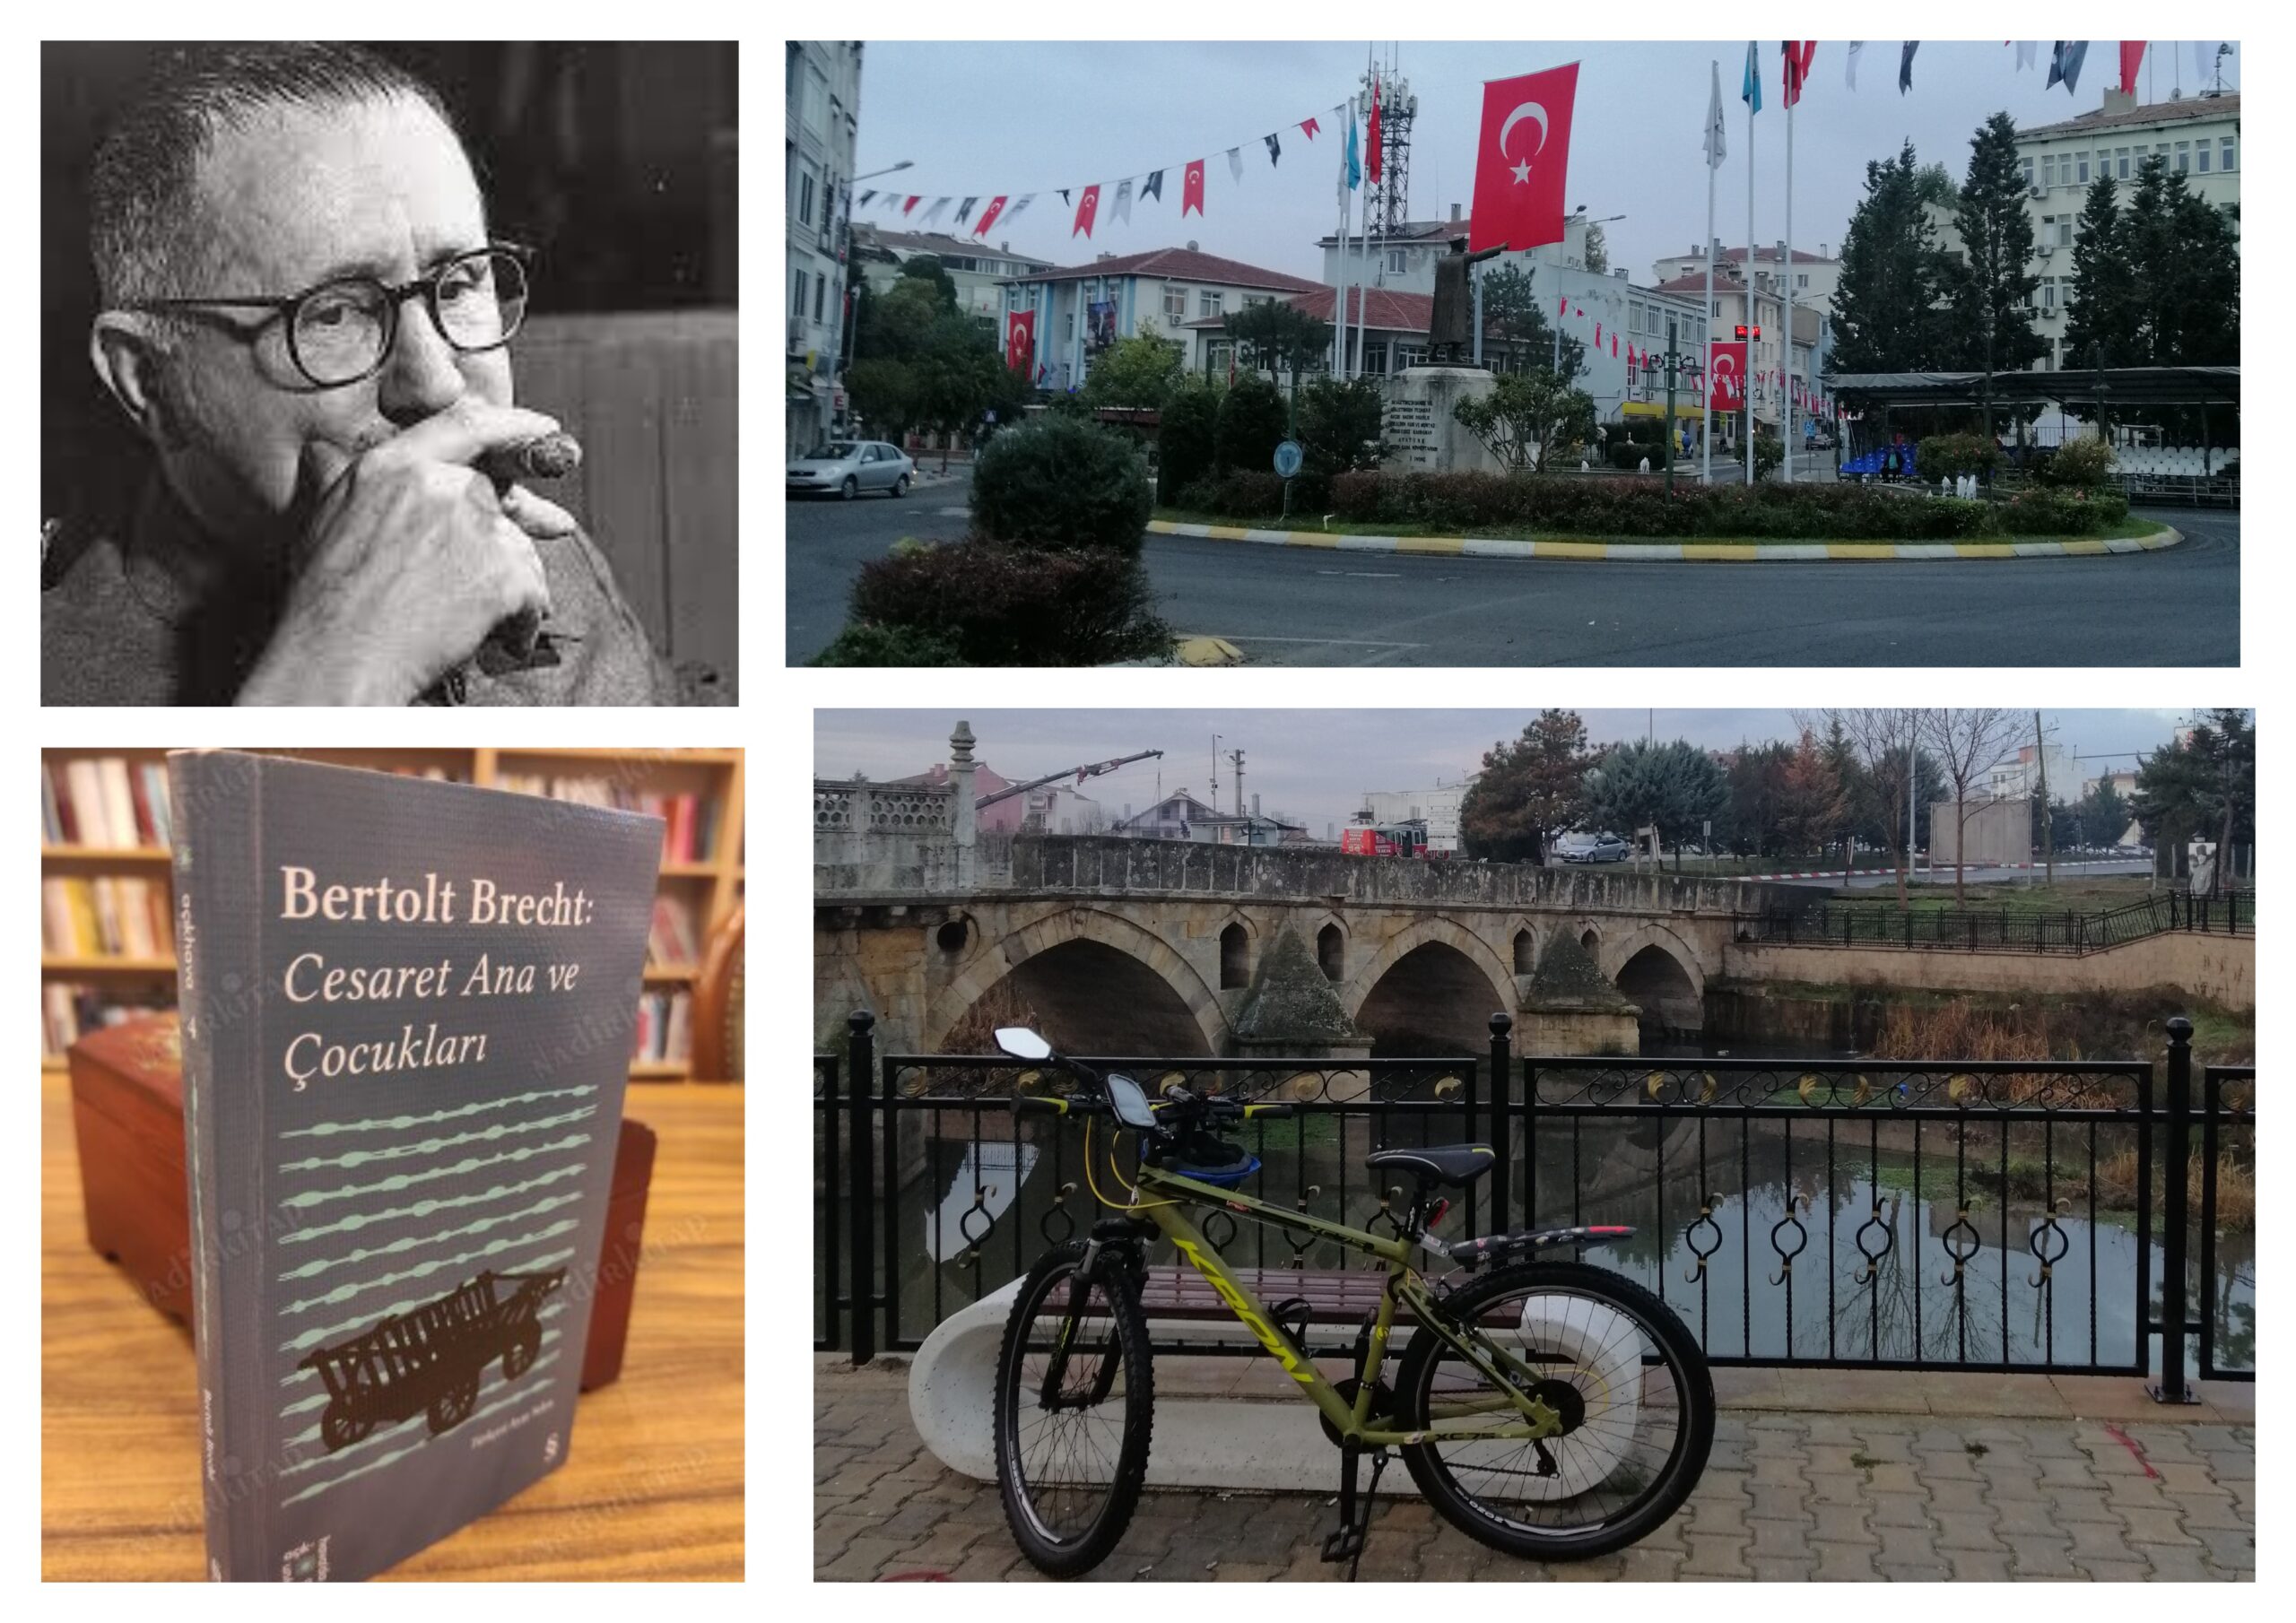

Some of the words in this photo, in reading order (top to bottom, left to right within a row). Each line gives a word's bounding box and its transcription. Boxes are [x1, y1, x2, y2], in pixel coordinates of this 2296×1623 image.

[281, 866, 457, 922] Bertolt
[469, 879, 594, 926] Brecht:
[283, 953, 453, 1002] Cesaret
[460, 953, 536, 997] Ana
[546, 963, 579, 993] ve
[284, 1024, 488, 1092] Çocukları
[1171, 1237, 1315, 1383] KRON
